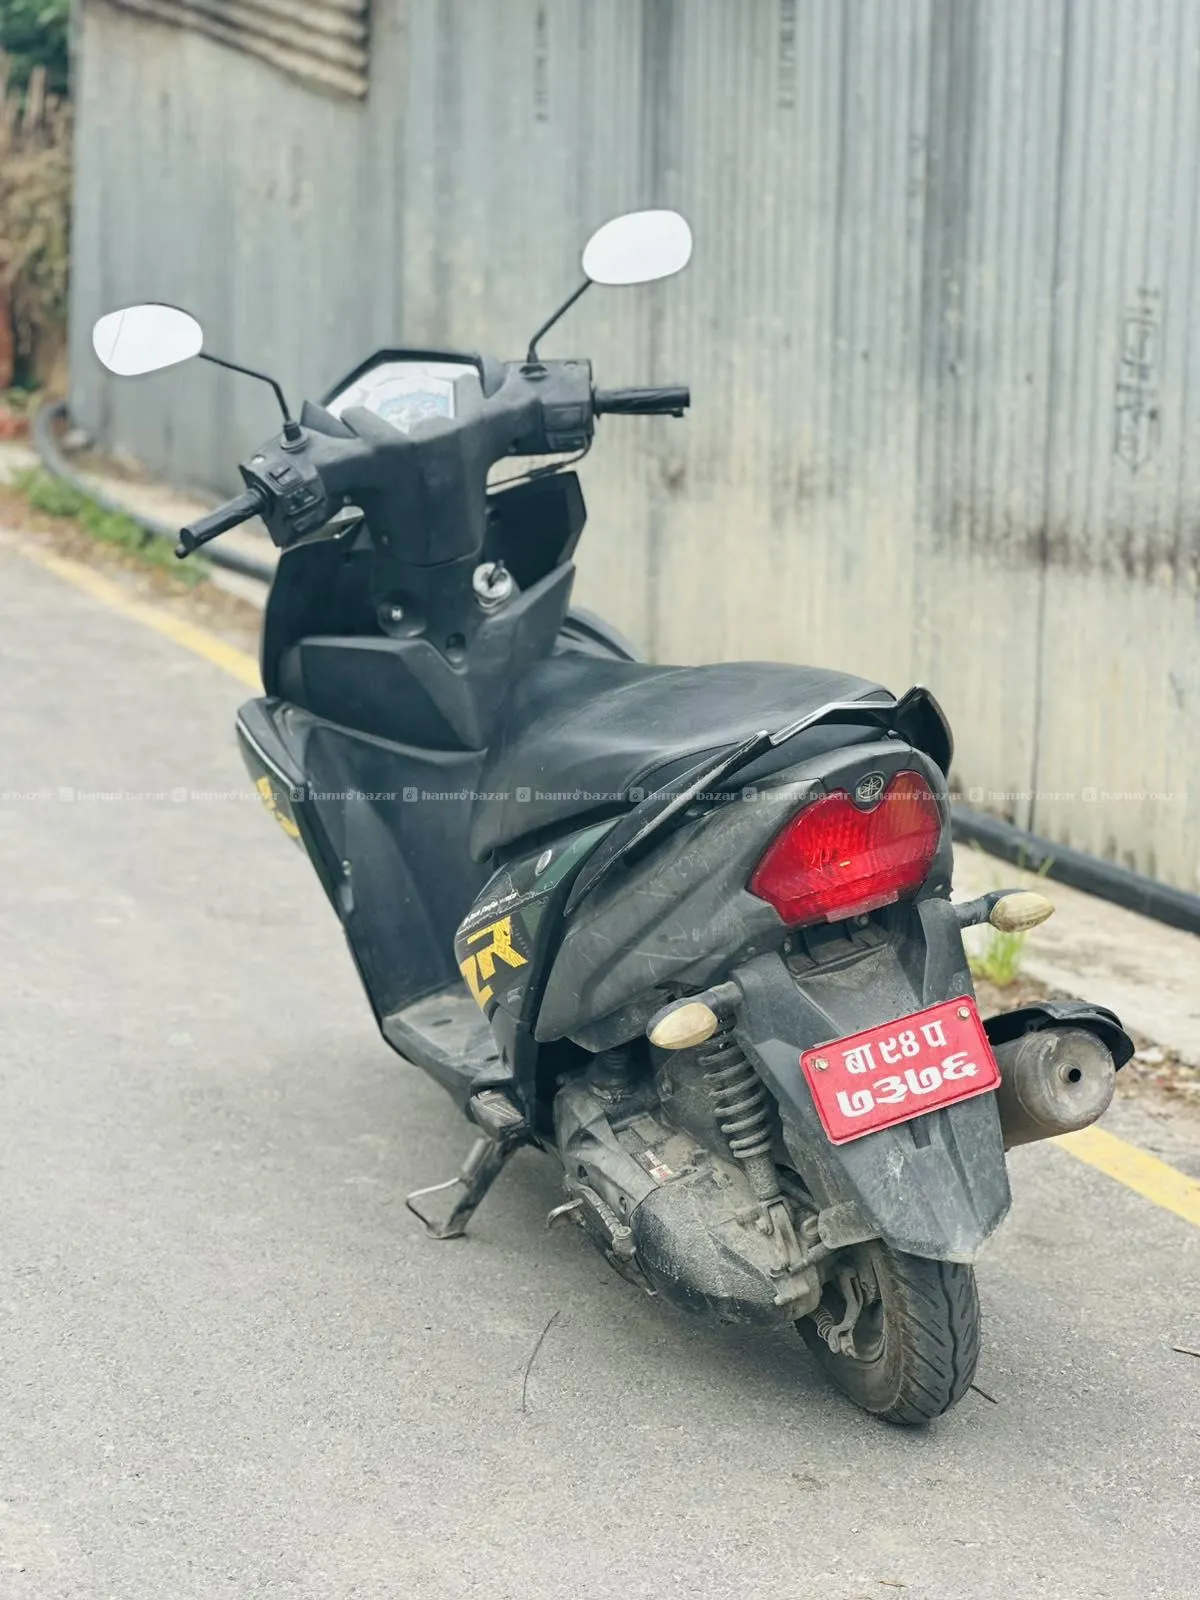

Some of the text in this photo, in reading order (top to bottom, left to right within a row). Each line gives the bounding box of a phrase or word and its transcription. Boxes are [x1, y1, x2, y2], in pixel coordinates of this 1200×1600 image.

[842, 1044, 876, 1074] बा
[920, 1021, 947, 1048] प
[836, 1052, 980, 1117] ७३७६
